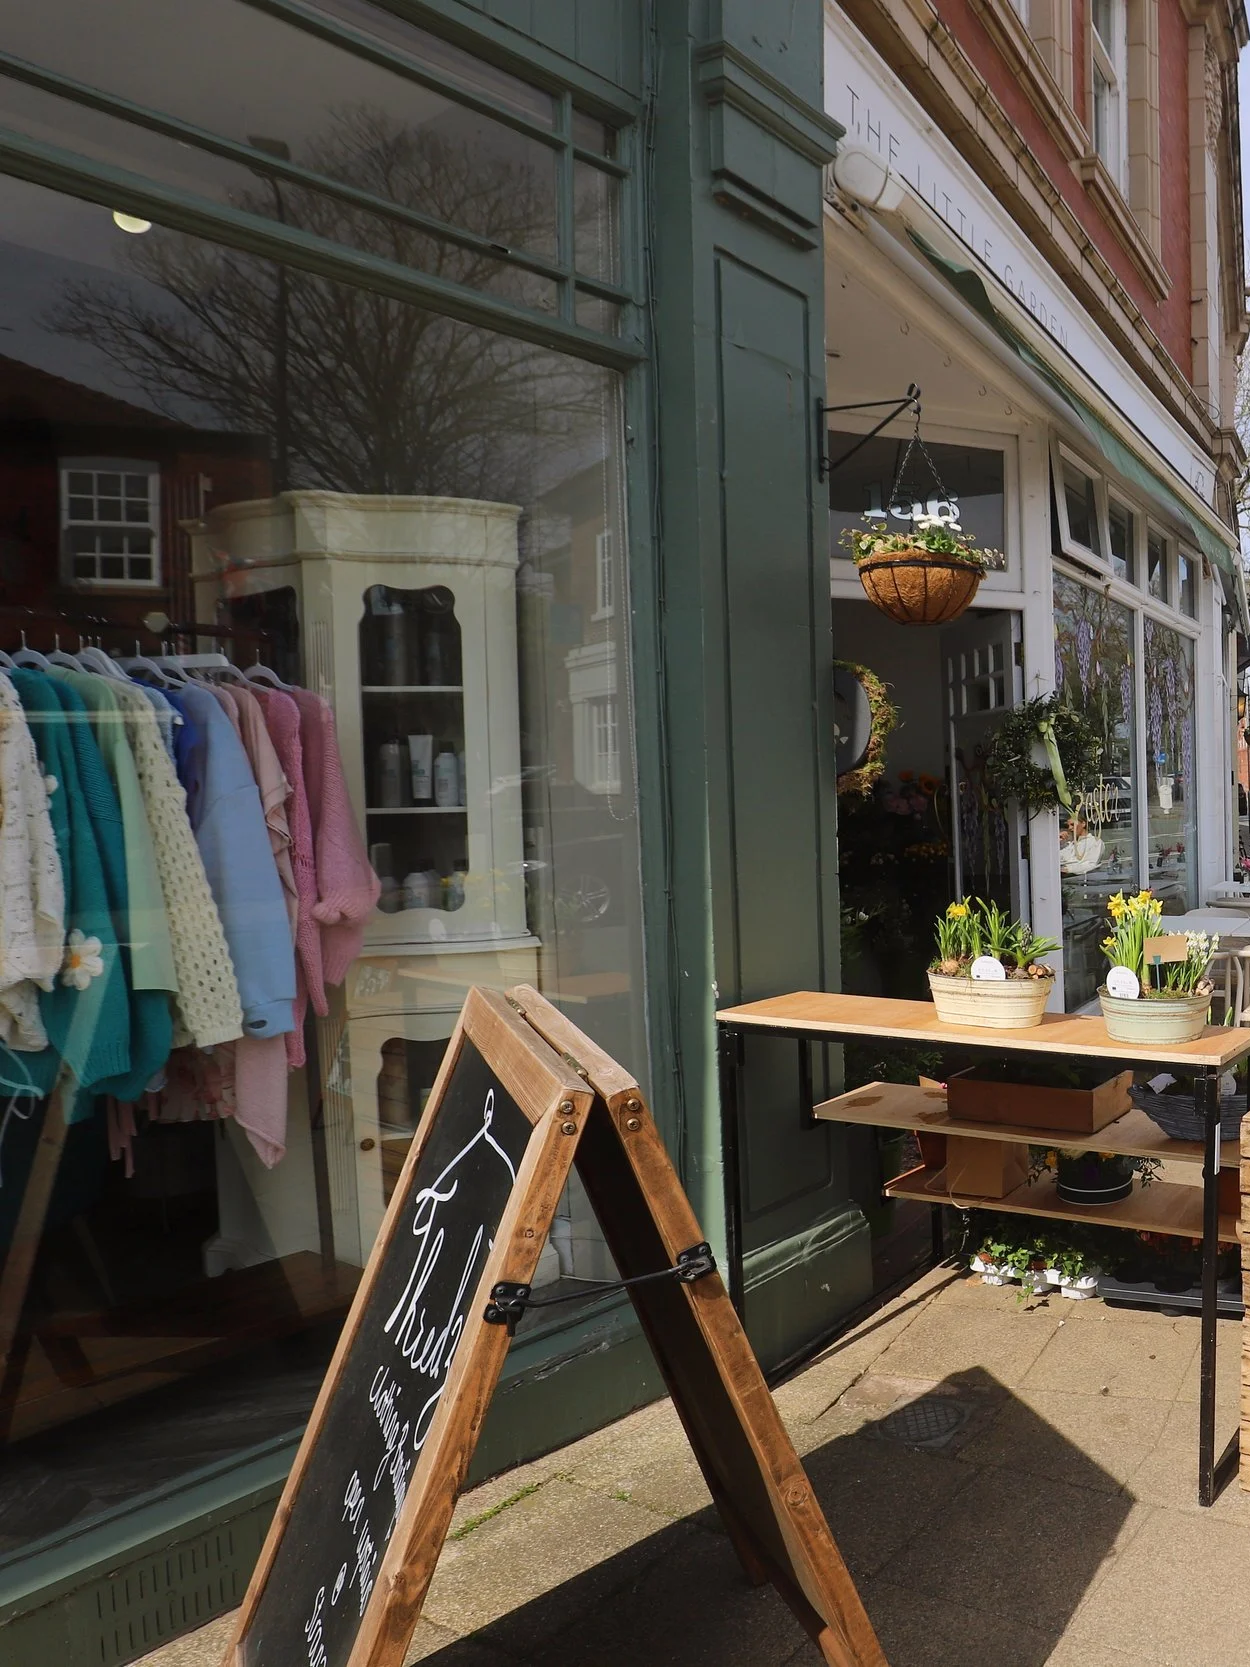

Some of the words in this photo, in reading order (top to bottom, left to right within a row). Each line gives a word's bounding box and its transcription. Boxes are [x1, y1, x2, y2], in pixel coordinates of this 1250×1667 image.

[1004, 264, 1068, 349] GARDEN
[863, 482, 960, 521] 156
[341, 1470, 365, 1535] open
